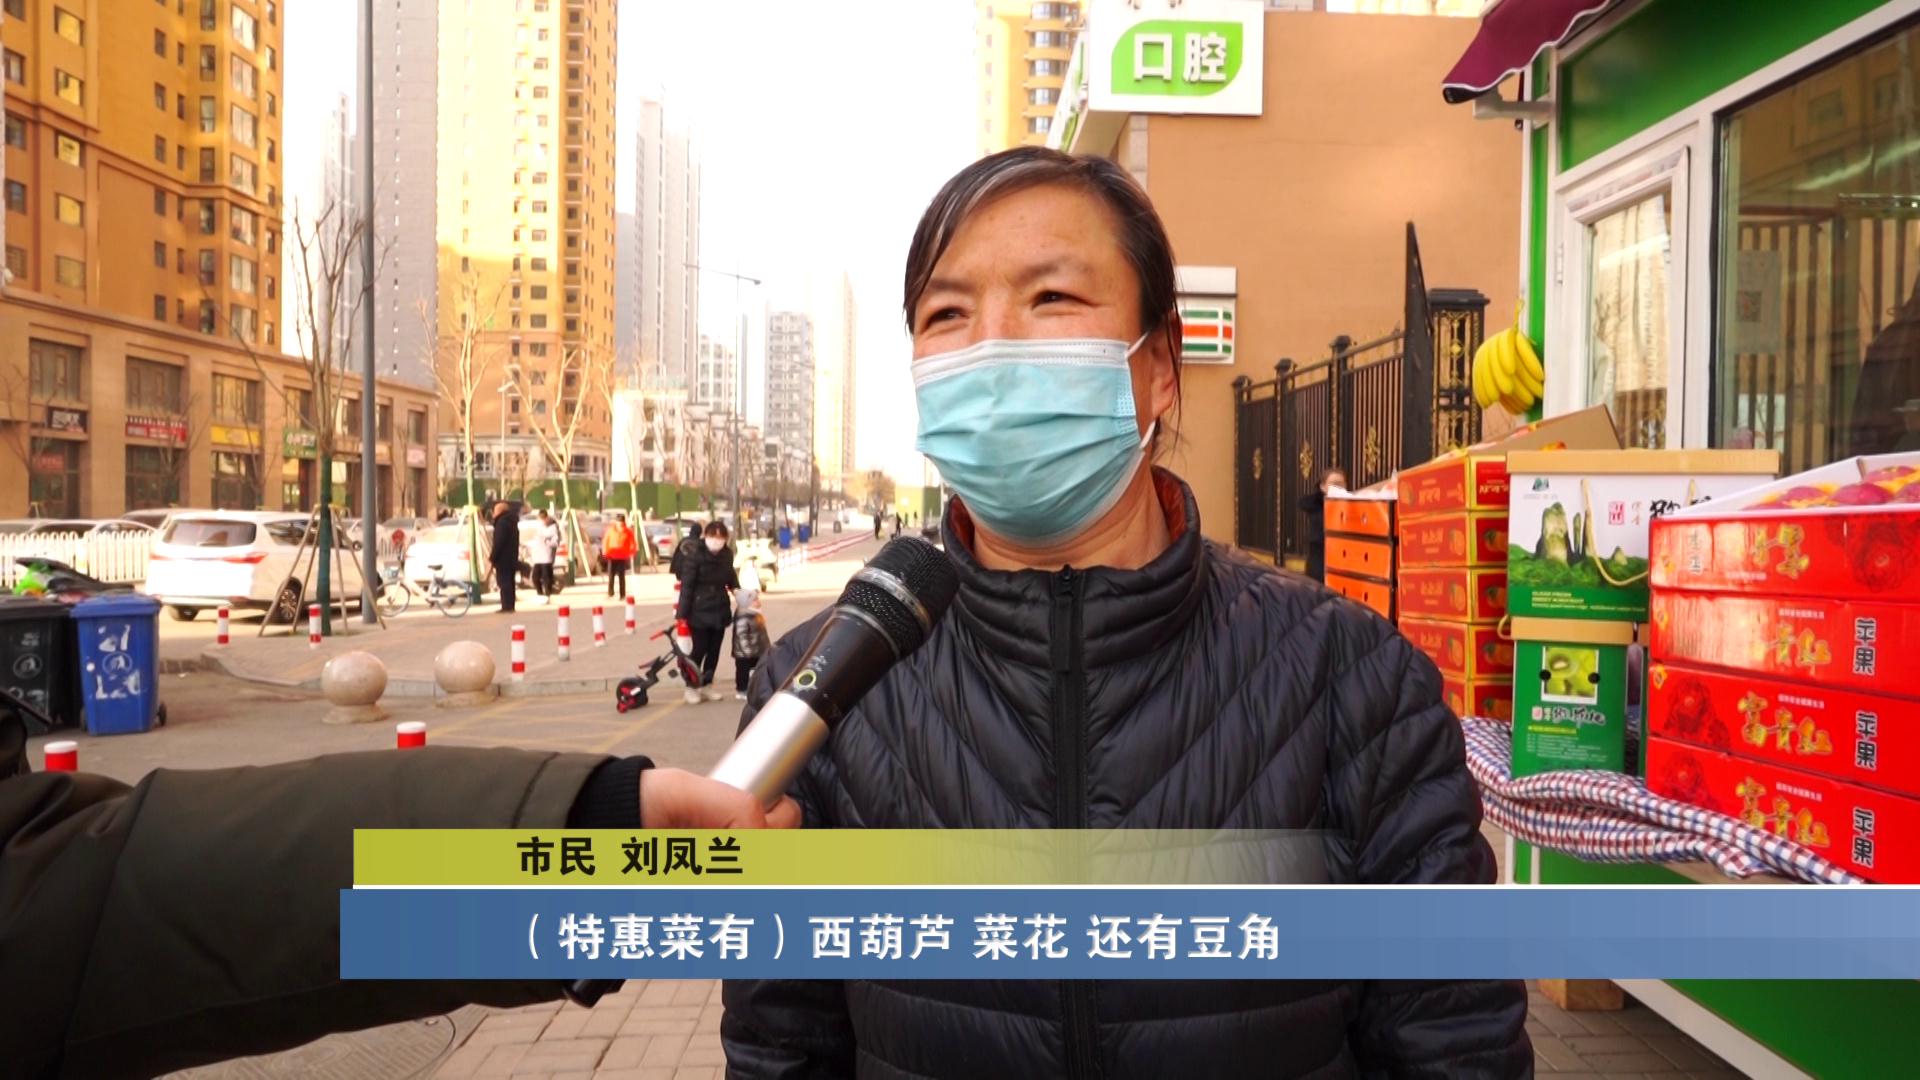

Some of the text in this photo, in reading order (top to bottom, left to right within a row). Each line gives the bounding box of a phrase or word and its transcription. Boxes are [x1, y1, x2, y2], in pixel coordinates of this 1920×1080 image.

[1134, 32, 1227, 83] 口腔
[1854, 616, 1876, 676] 苹果
[1855, 709, 1877, 771] 苹果
[1852, 806, 1875, 869] 苹果
